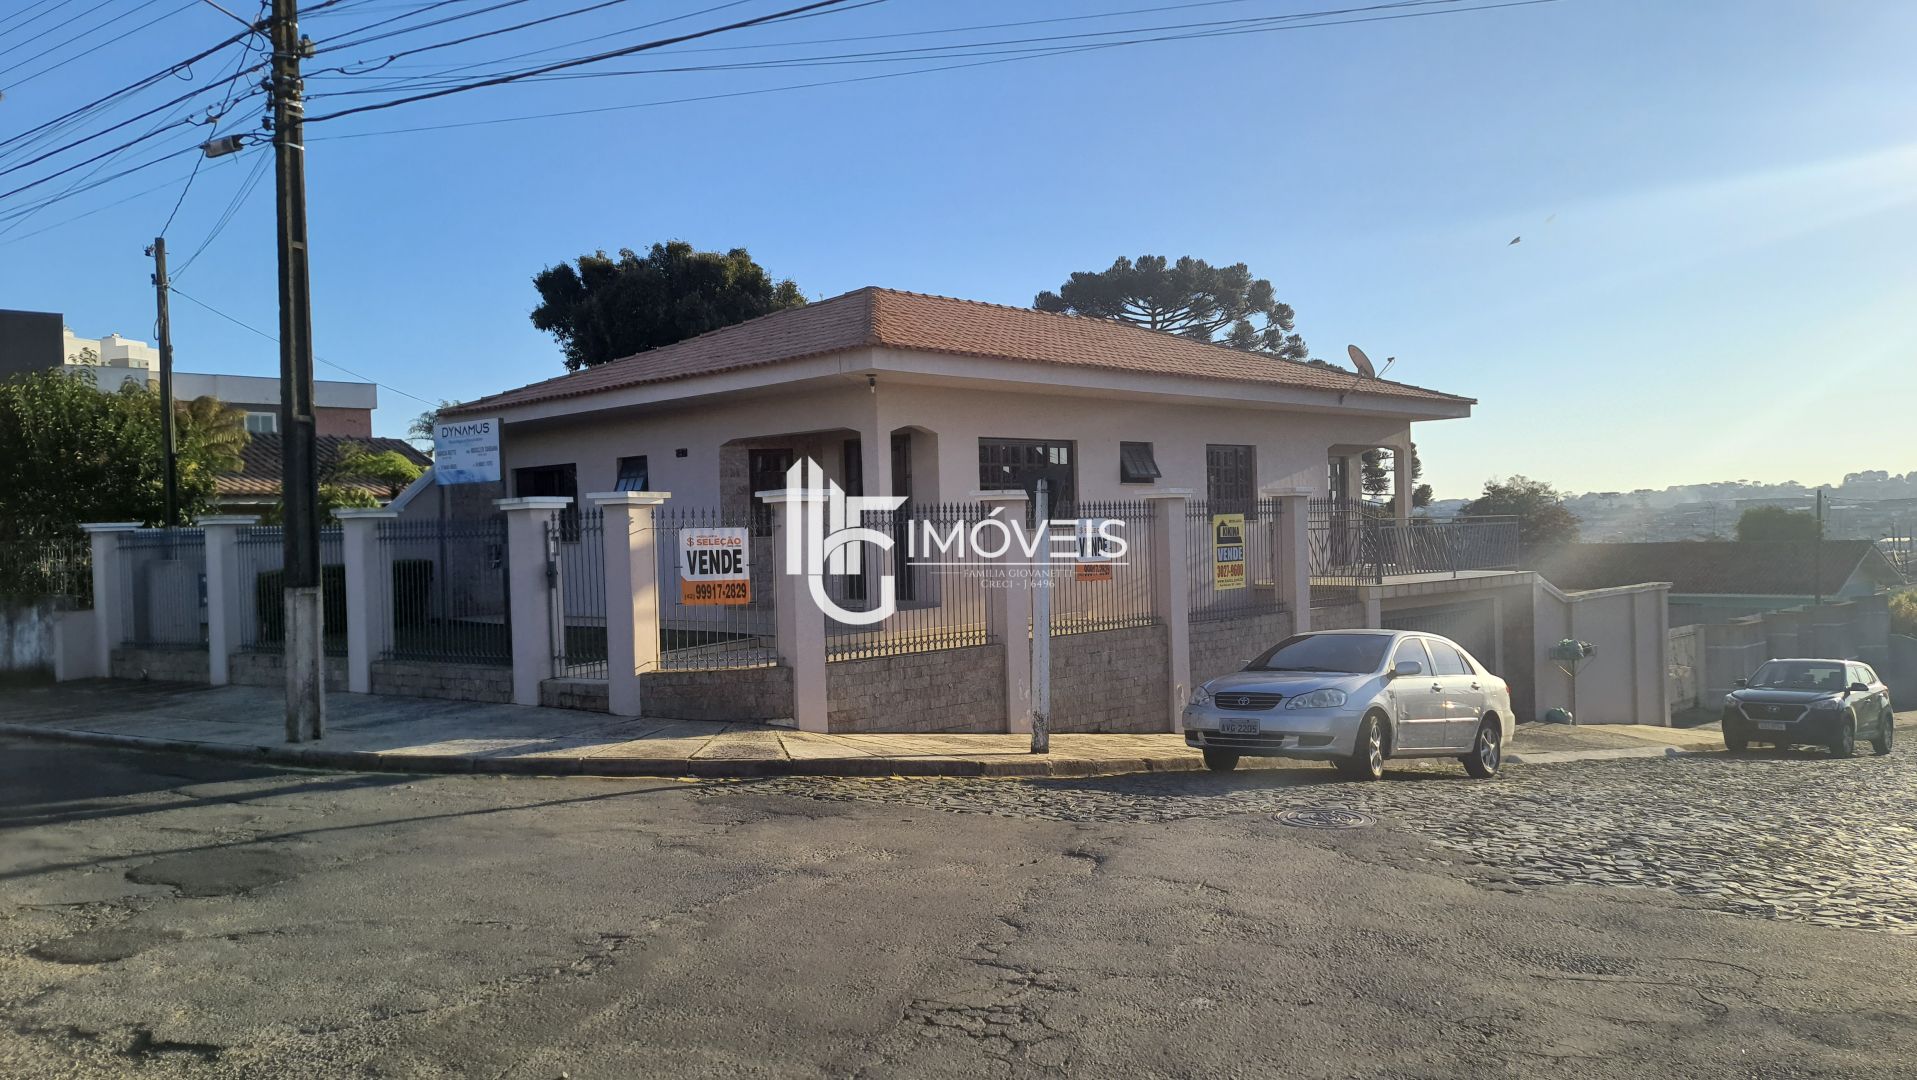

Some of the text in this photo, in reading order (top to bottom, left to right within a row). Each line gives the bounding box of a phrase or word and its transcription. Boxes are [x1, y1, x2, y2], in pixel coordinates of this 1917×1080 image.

[442, 422, 490, 438] DYNAMUS
[696, 536, 742, 547] SELEÇÃO
[1079, 536, 1108, 557] VNDE
[686, 549, 743, 575] VENDE
[1217, 547, 1243, 562] VENDE
[695, 583, 747, 600] 99917-2829
